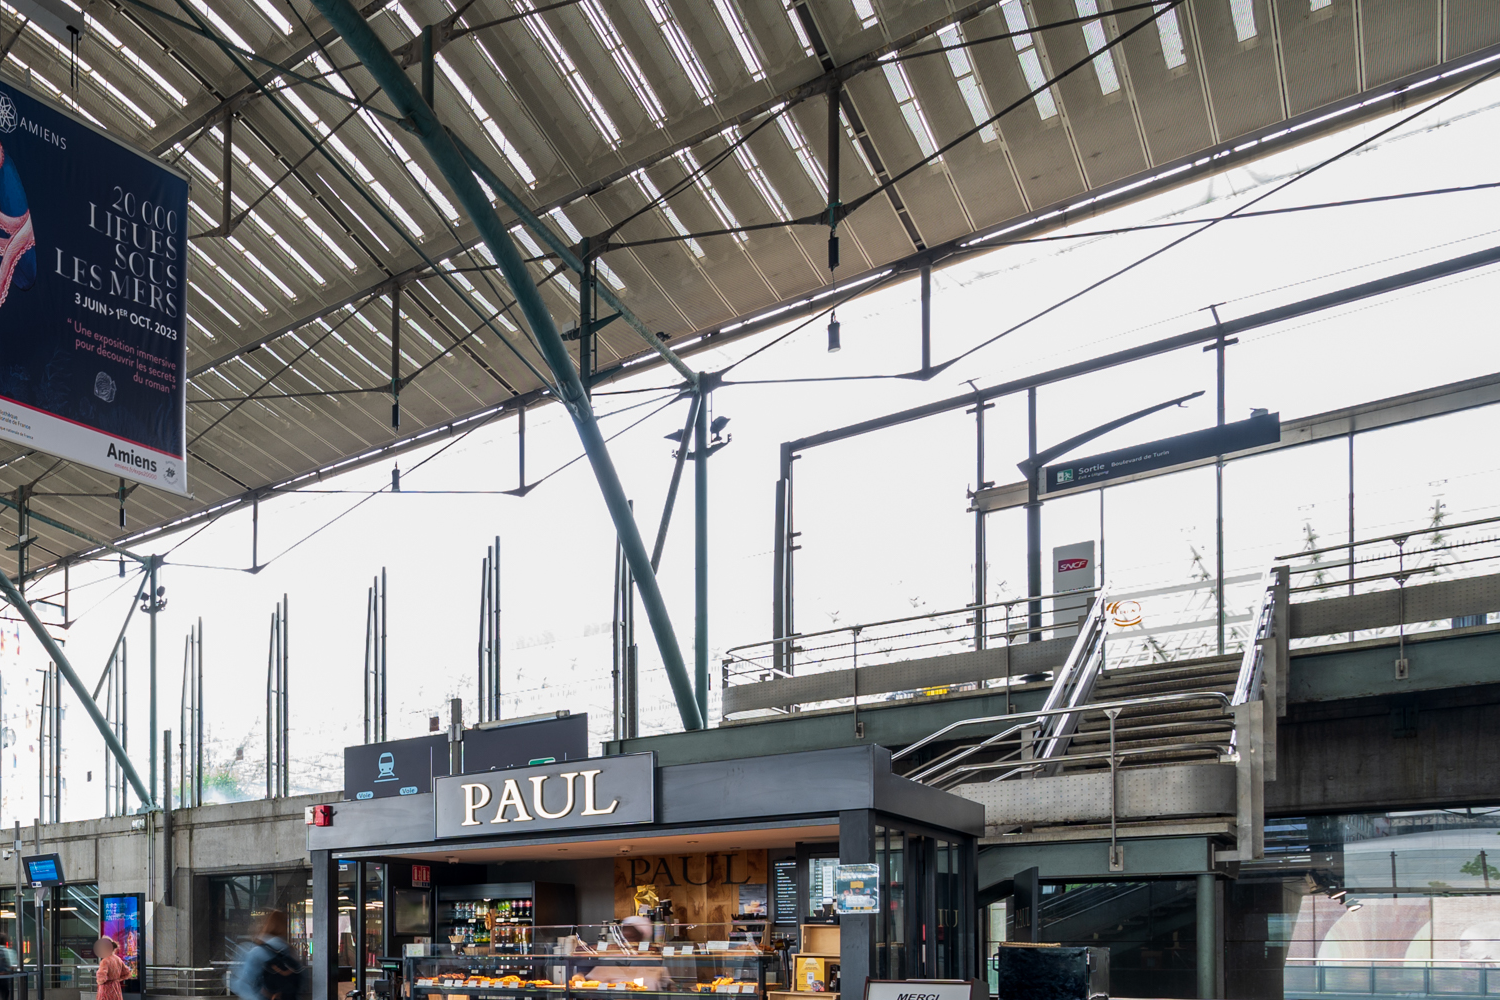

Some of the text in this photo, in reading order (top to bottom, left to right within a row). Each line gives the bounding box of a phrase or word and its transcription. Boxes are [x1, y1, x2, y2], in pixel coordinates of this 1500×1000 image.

[20, 117, 67, 150] AMIENS
[88, 201, 177, 261] LIEUES
[112, 186, 177, 234] 20 000
[55, 247, 177, 318] LES MERS
[115, 243, 177, 290] SOUS
[74, 292, 81, 305] 3
[82, 296, 107, 316] JUIN
[129, 313, 153, 331] OCT.
[155, 322, 177, 341] 2023
[74, 320, 176, 371] Une exposition immersive
[75, 339, 176, 384] pour découvrir les secrets
[133, 371, 170, 394] du roman
[18, 420, 31, 431] France
[107, 442, 157, 472] Amiens
[1078, 463, 1105, 475] Sortie
[1111, 456, 1142, 468] Boulevard
[1059, 560, 1086, 571] SNCF
[461, 769, 620, 827] PAUL
[627, 854, 751, 888] PAUL
